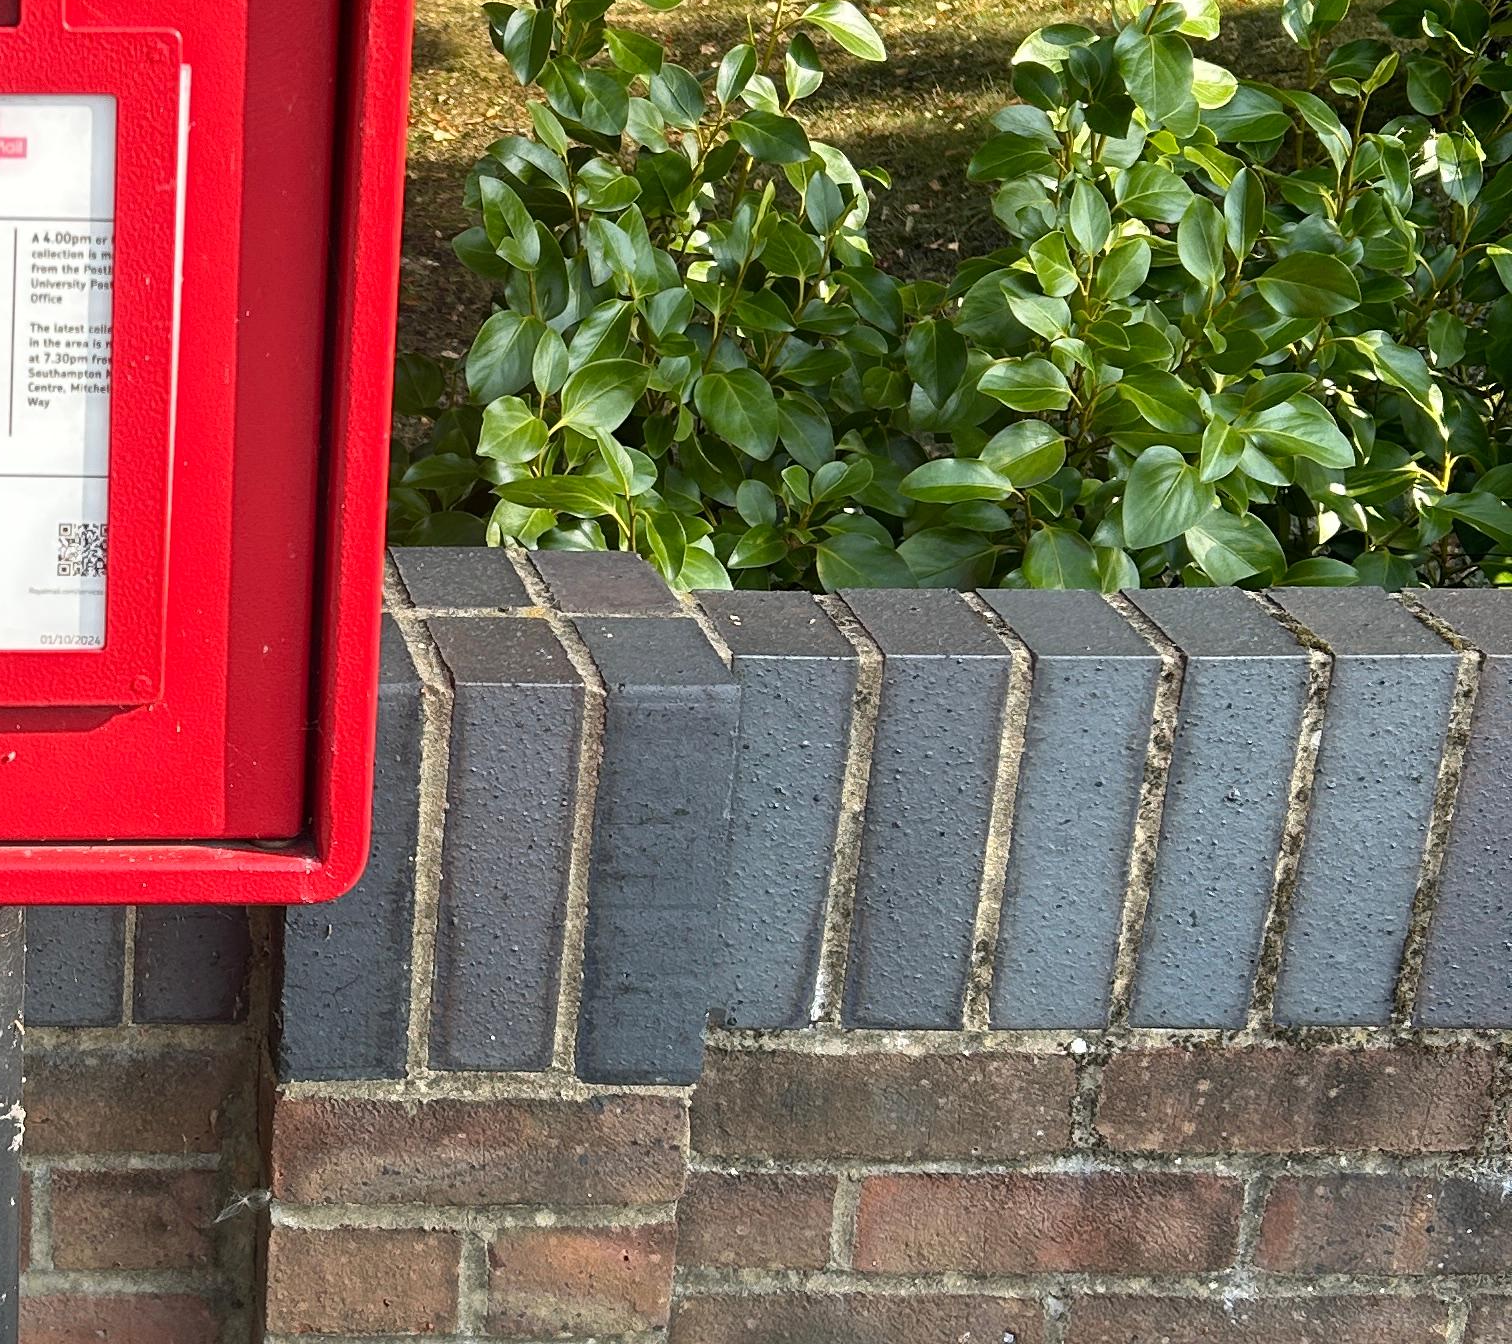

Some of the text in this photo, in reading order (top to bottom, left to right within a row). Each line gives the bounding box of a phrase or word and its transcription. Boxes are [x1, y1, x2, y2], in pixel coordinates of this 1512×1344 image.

[32, 233, 39, 244] A
[43, 232, 92, 247] 4.00pm
[31, 249, 84, 259] collection
[89, 249, 97, 260] is
[31, 264, 58, 274] from
[62, 264, 80, 274] the
[31, 278, 86, 292] University
[30, 293, 62, 304] Office
[30, 322, 50, 333] The
[54, 323, 84, 334] latest
[29, 338, 39, 348] in
[44, 338, 61, 348] the
[65, 340, 88, 348] area
[93, 340, 102, 349] is
[29, 354, 39, 364] at
[44, 352, 88, 366] 7.30pm
[28, 367, 101, 379] Southampton
[70, 383, 112, 394] Mitchel
[28, 397, 50, 409] Way
[40, 634, 101, 645] 01/10/2024
